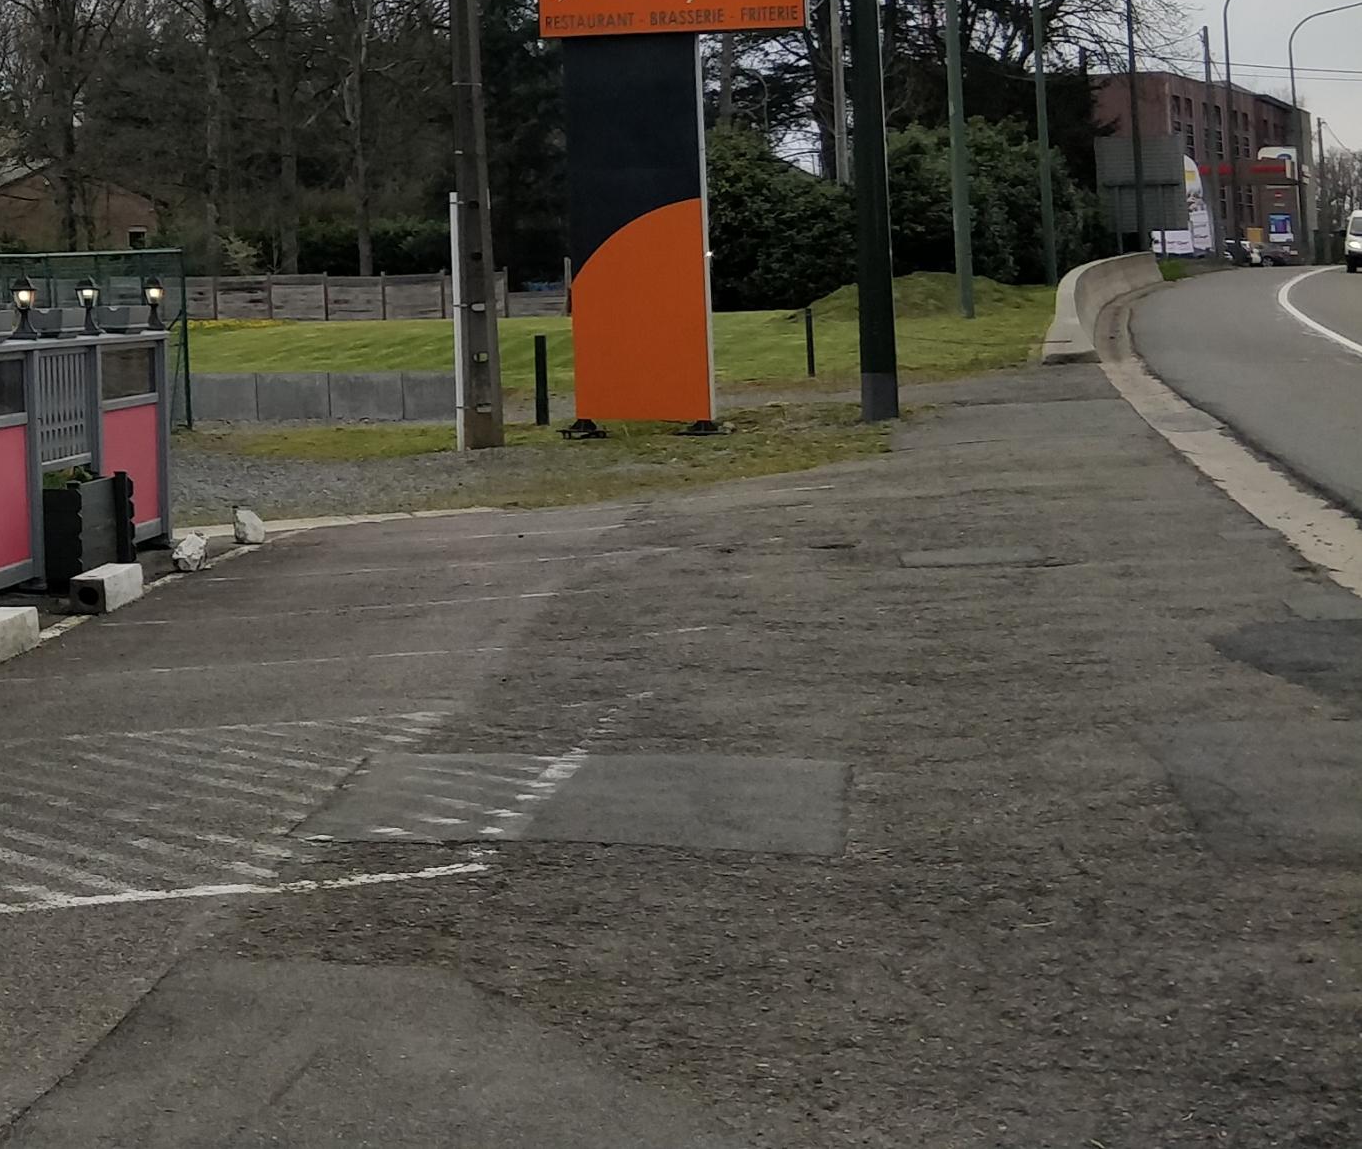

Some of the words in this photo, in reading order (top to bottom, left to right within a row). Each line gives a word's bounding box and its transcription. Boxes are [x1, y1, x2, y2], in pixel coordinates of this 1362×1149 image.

[545, 12, 635, 30] RESTAURANT
[650, 9, 723, 26] BRASSERIE
[741, 5, 798, 22] FRITERIE
